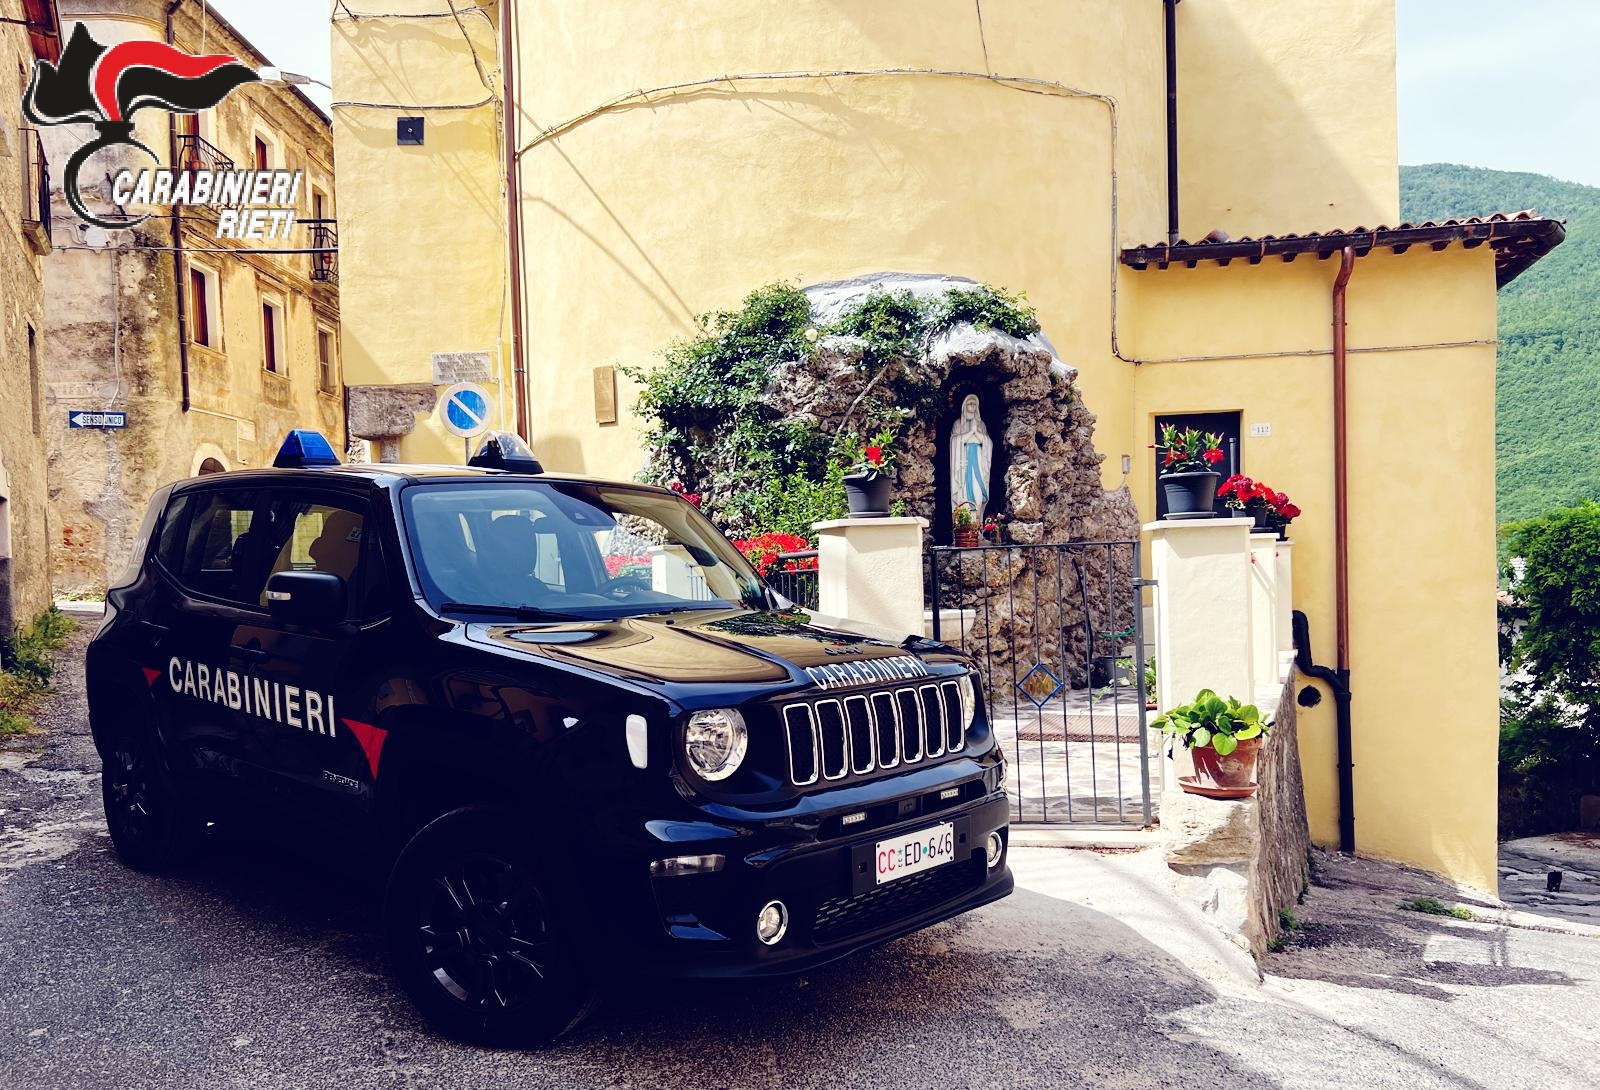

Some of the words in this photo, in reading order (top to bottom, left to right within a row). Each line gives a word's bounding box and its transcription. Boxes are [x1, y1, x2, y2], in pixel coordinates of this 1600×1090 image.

[82, 414, 103, 425] SENSO
[104, 415, 122, 425] UNICO
[805, 655, 928, 691] CARABINIERI
[168, 655, 337, 738] CARABINIERI
[878, 848, 896, 874] CC
[904, 841, 921, 867] ED
[928, 832, 953, 859] 646
